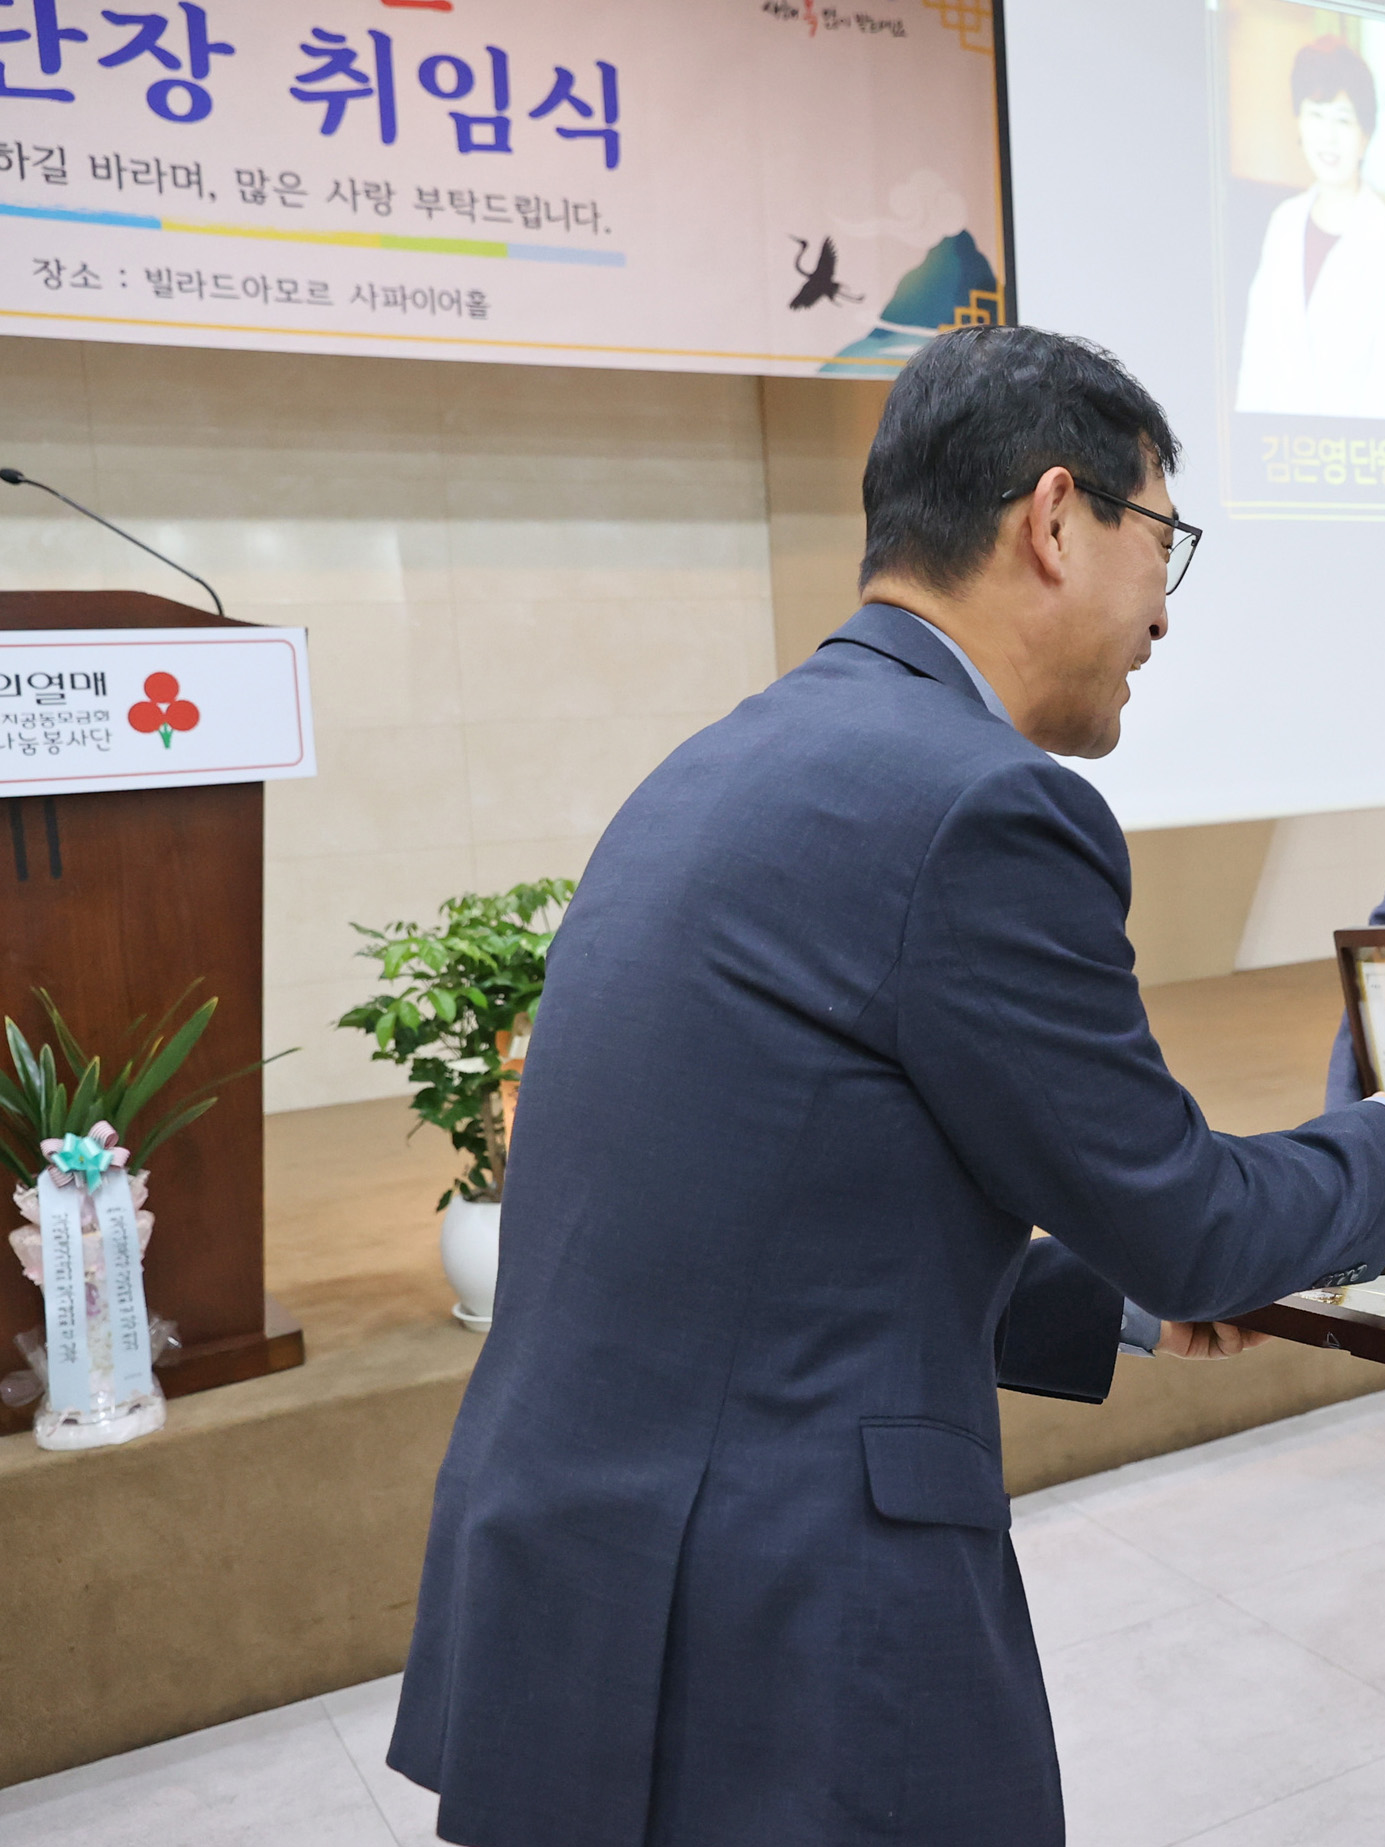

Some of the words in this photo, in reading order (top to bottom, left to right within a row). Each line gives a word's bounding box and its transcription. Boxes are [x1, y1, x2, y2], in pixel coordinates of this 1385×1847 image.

[290, 28, 621, 170] 취임식
[0, 141, 68, 186] 하길
[88, 152, 216, 202] 바라며,
[235, 167, 308, 208] 많은
[326, 178, 397, 217] 사랑
[414, 186, 612, 234] 부탁드립니다.
[33, 256, 103, 291] 장소
[144, 266, 334, 308] 빌라드아모르
[349, 283, 490, 319] 사파이어홀
